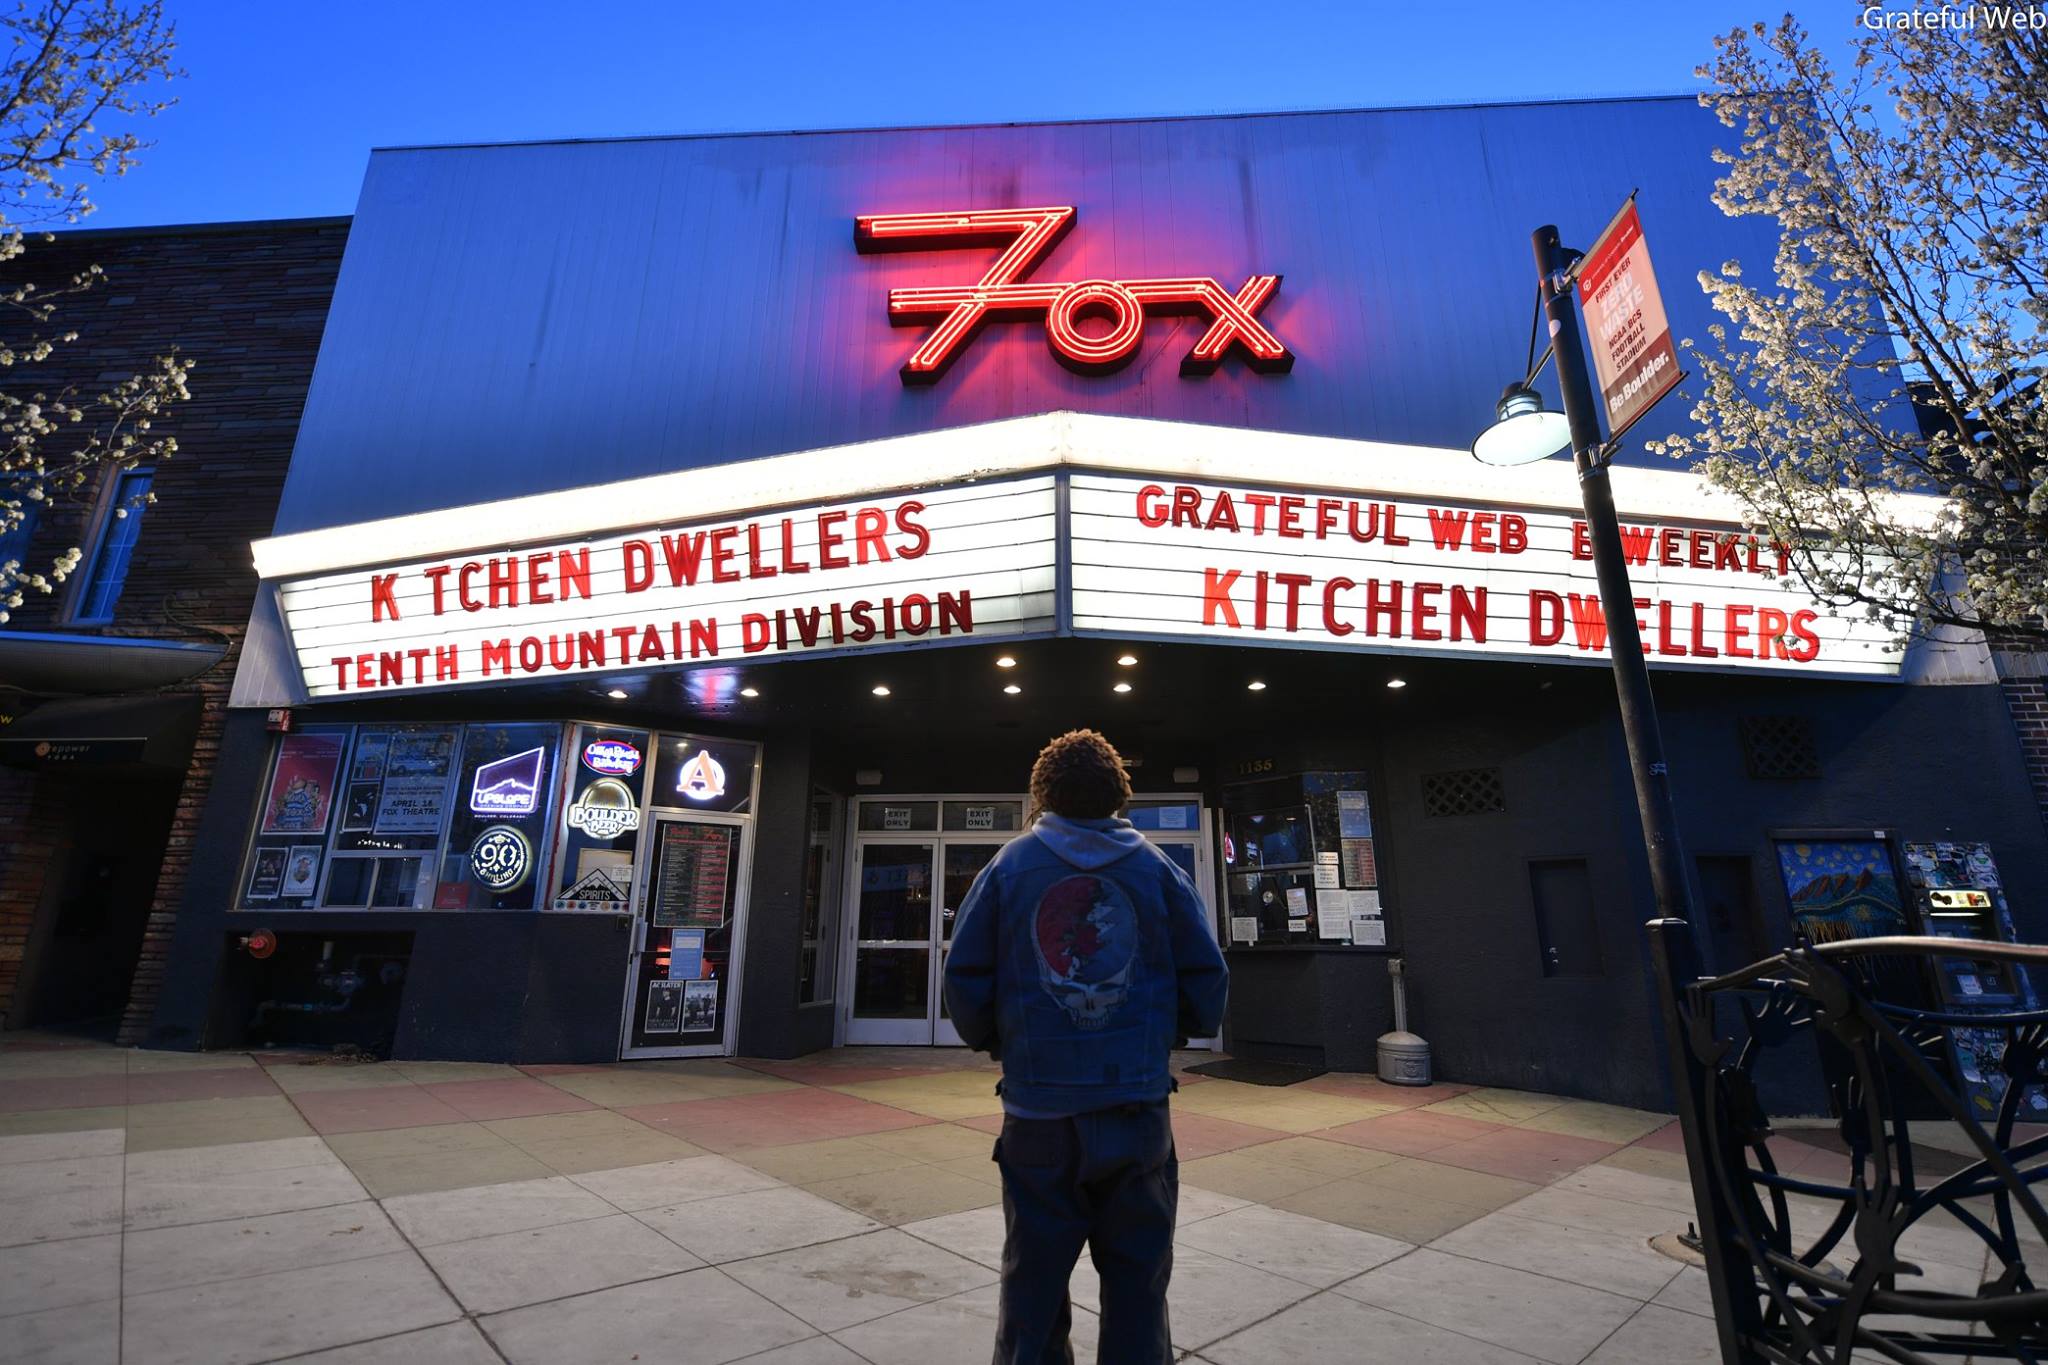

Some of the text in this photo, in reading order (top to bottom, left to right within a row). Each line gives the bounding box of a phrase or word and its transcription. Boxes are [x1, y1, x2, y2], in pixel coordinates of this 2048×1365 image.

[1595, 256, 1631, 303] FIRST EVER
[1600, 272, 1633, 318] ZERO
[1600, 283, 1644, 340] WASTE
[1608, 308, 1642, 349] NCAA BCS
[1611, 322, 1645, 361] FOOTBALL
[1616, 336, 1647, 372] STADIUM
[1609, 351, 1669, 414] Be Boulder.
[623, 500, 931, 594] DWELLERS
[1136, 484, 1794, 576] GRATEFUL WEB BWEEKLY
[1202, 567, 1822, 663] KITCHEN DWLLERS
[331, 590, 975, 692] TENTH MOUNTAIN DIVISION
[477, 793, 531, 805] UPSLOPE
[575, 807, 636, 826] BOULDER
[590, 820, 618, 833] BEER
[480, 843, 517, 868] 90
[579, 889, 611, 900] SPIRITS
